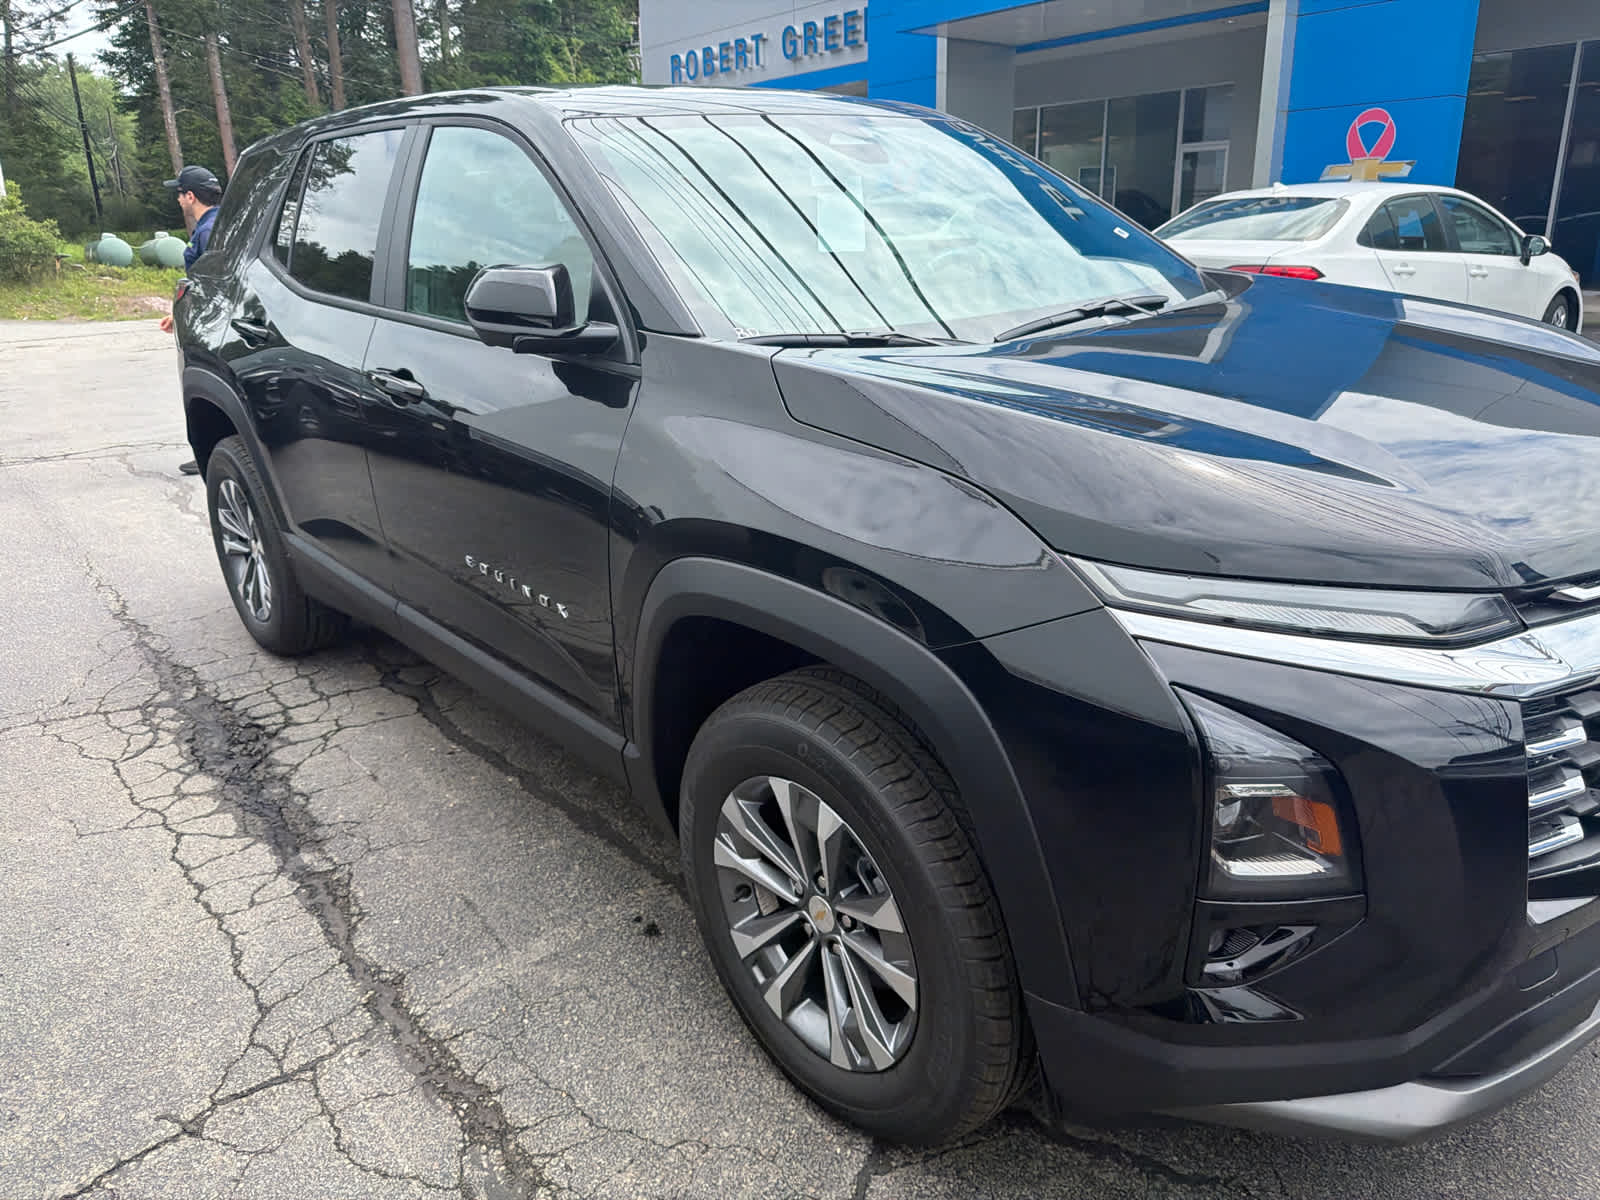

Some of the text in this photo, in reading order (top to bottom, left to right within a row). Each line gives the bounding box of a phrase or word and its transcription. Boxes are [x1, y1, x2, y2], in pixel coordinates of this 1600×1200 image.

[670, 7, 868, 85] ROBERT GREE
[465, 554, 569, 619] EQUINOX
